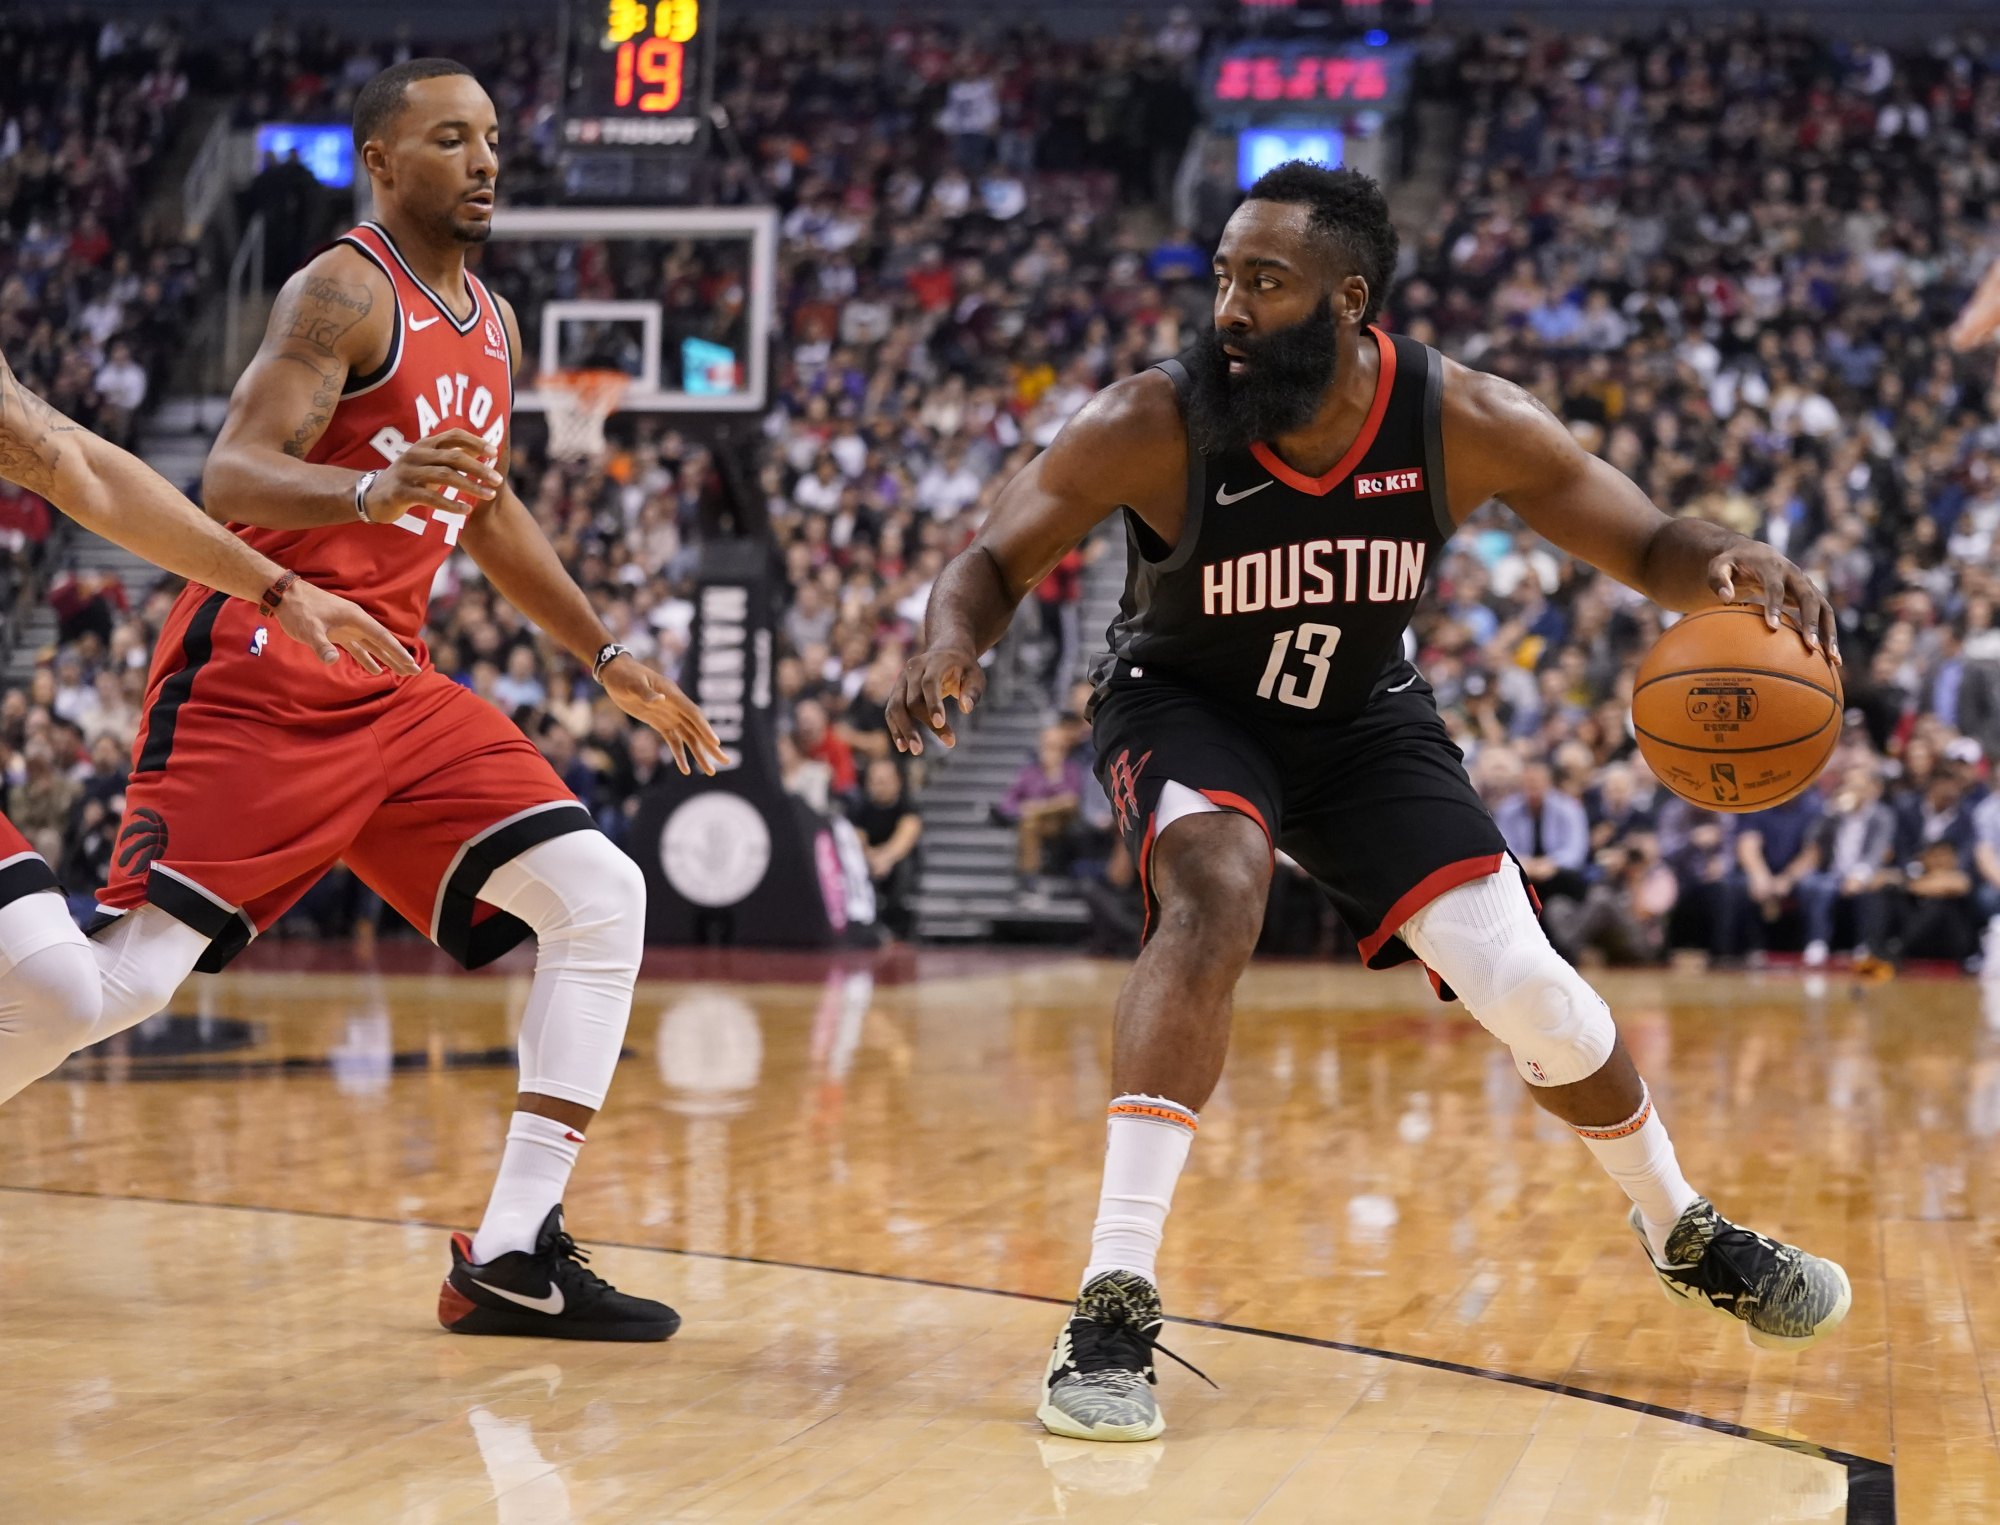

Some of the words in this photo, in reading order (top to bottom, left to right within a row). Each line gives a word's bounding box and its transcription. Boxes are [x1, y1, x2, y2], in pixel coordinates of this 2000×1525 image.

[614, 37, 684, 112] 19
[1202, 538, 1427, 616] HOUSTON
[1255, 621, 1342, 710] 13
